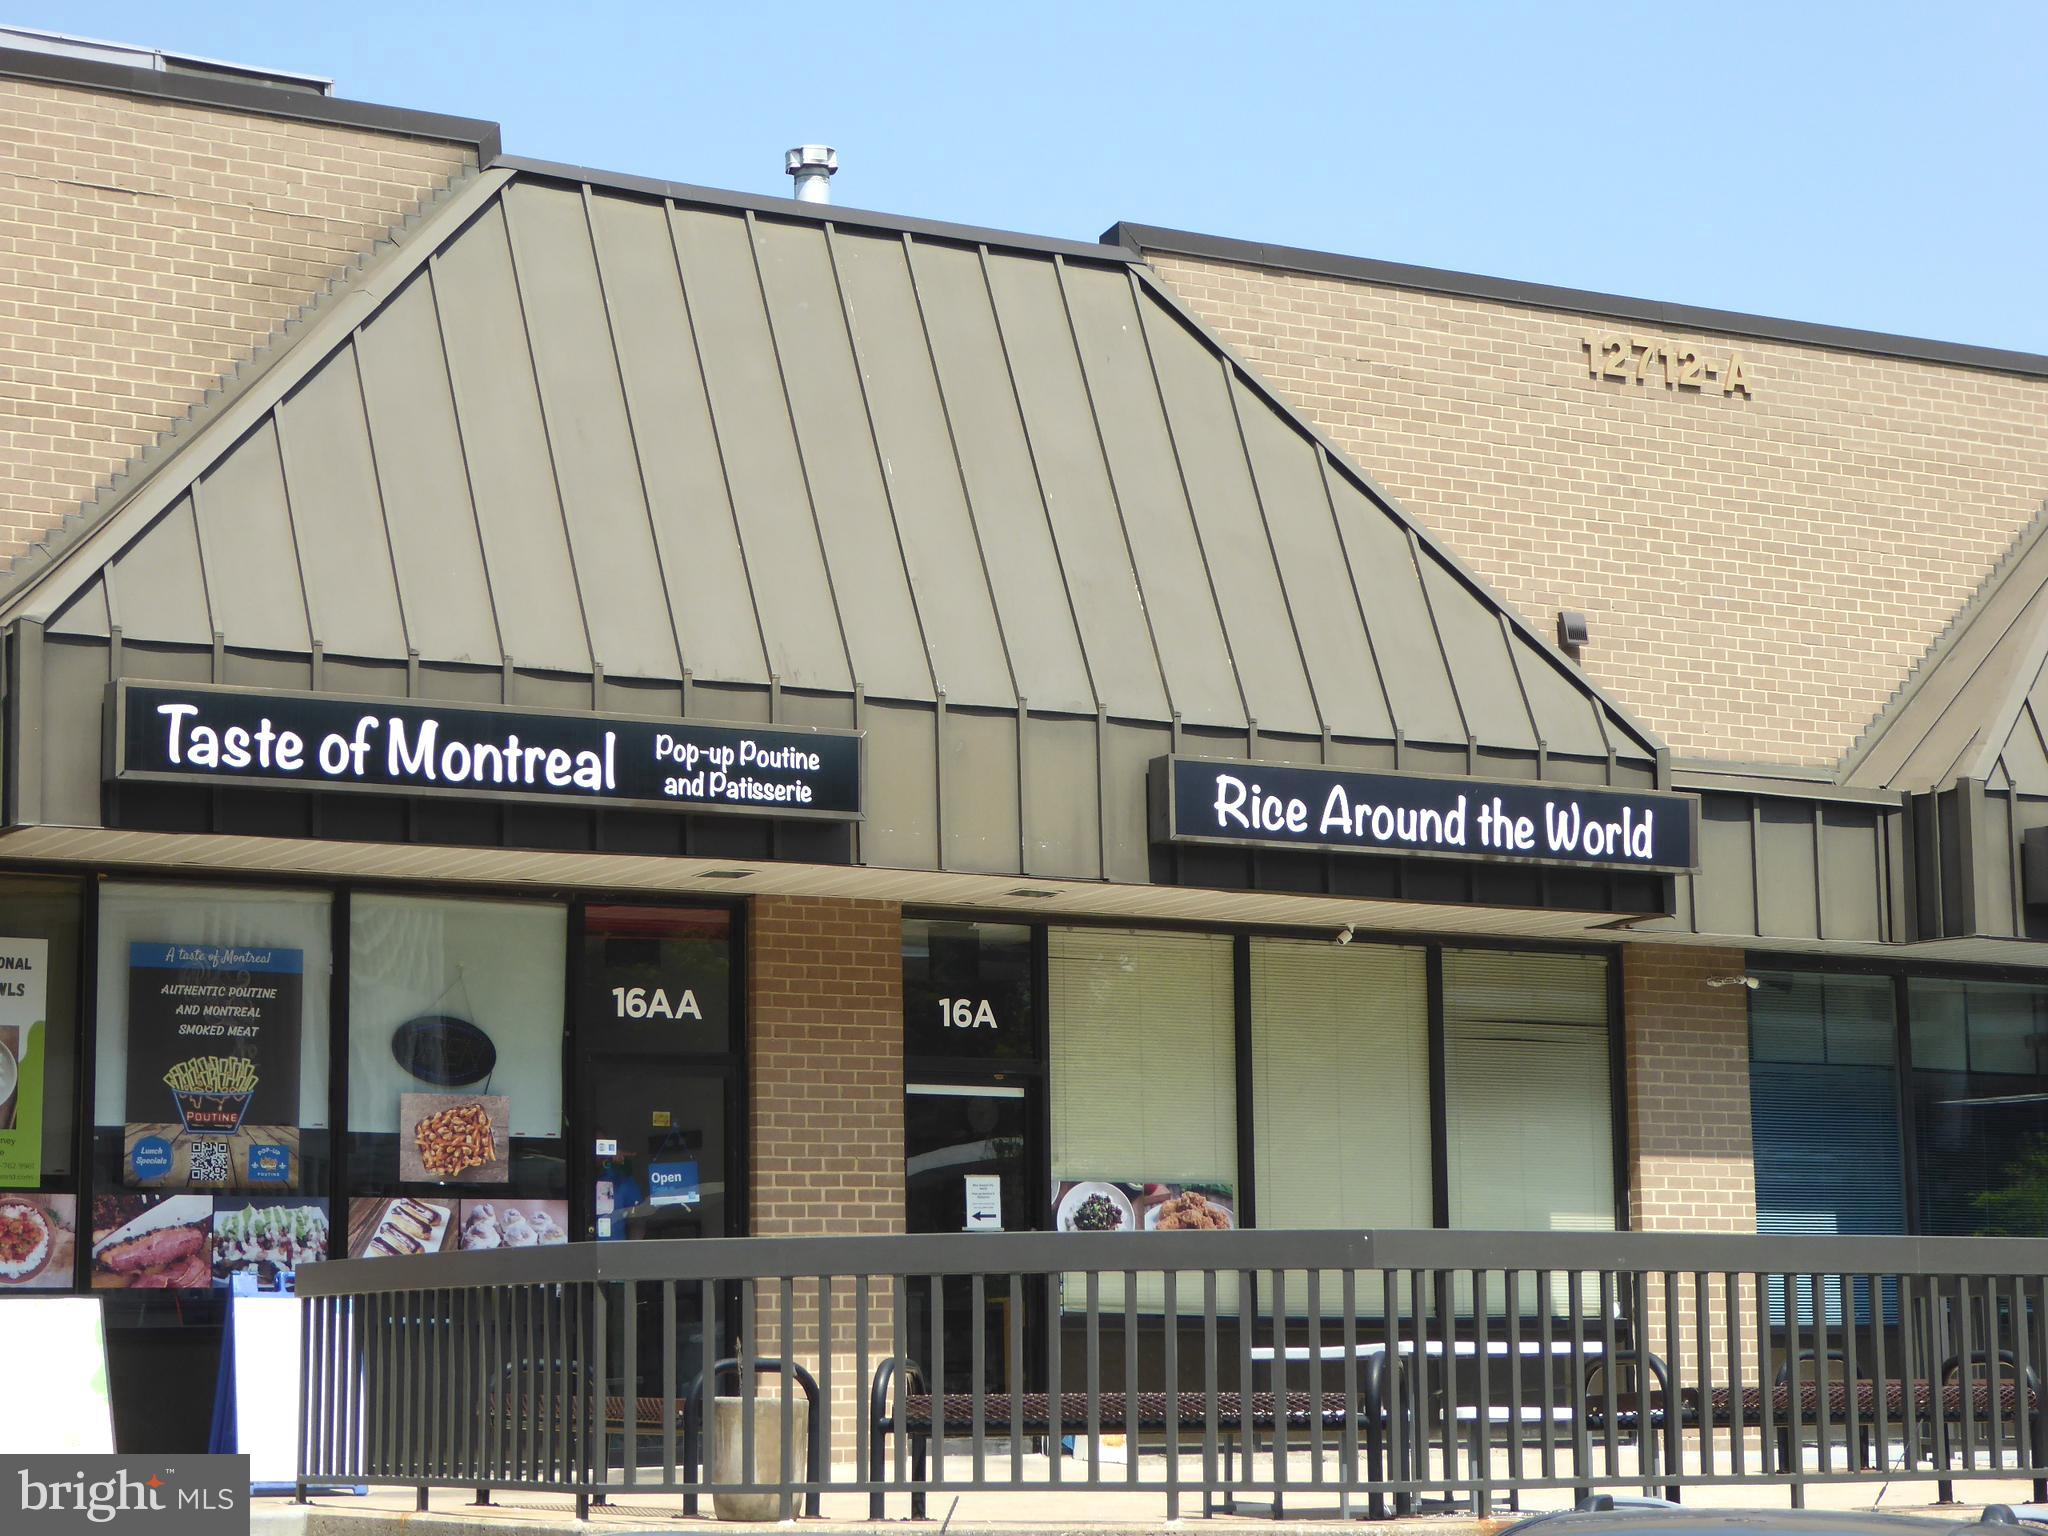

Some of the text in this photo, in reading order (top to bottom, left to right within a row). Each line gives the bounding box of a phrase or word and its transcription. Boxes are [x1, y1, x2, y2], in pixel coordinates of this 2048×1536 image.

[1582, 335, 1752, 397] 12712-A
[157, 703, 617, 791] Taste of Montreal
[655, 733, 821, 774] Pop-up Poutine
[663, 771, 813, 803] and Patisserie
[1213, 773, 1653, 860] Rice Around the World
[165, 947, 271, 967] A taste of Montreal
[161, 984, 278, 999] AUTHENTIC POUTINE
[612, 987, 703, 1020] 16AA
[175, 1004, 261, 1018] AND MONTREAL
[938, 997, 999, 1029] 16A
[178, 1024, 260, 1037] SMOKED MEAT
[186, 1111, 238, 1122] POUTINE
[140, 1147, 163, 1155] Lunch
[651, 1172, 682, 1184] Open
